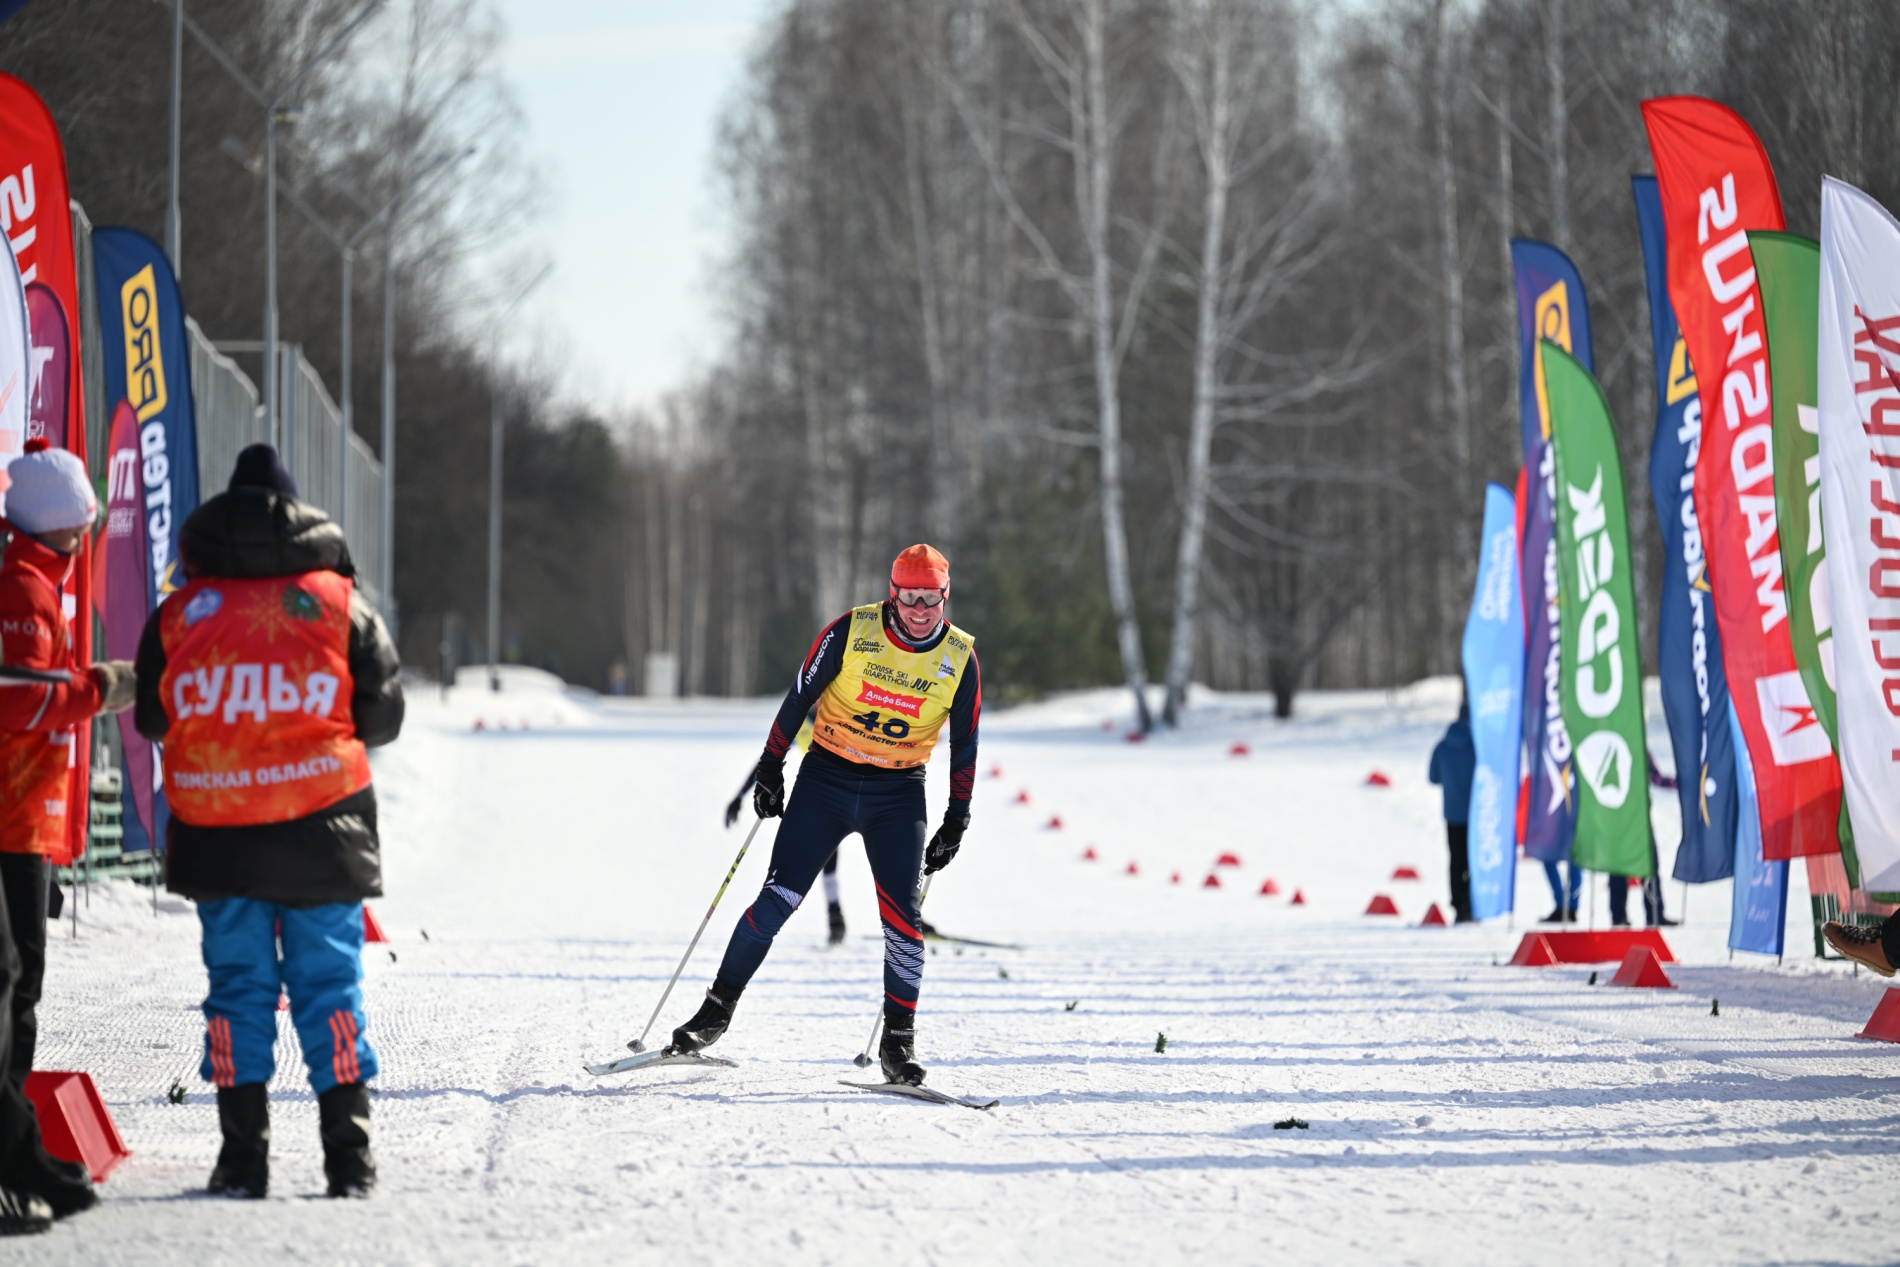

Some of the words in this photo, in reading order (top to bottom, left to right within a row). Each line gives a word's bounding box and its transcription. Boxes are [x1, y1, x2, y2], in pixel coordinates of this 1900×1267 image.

[857, 637, 880, 648] Саша
[804, 630, 835, 685] NORDSKI
[862, 668, 910, 688] MARATHON
[866, 661, 895, 676] TOMSK
[896, 670, 909, 680] SKI
[173, 663, 339, 725] СУДЬЯ
[865, 690, 895, 704] Альфа
[895, 698, 918, 710] Банк
[852, 711, 910, 739] 40
[173, 769, 252, 788] ТОМСКАЯ
[256, 754, 341, 787] ОБЛАСТЬ
